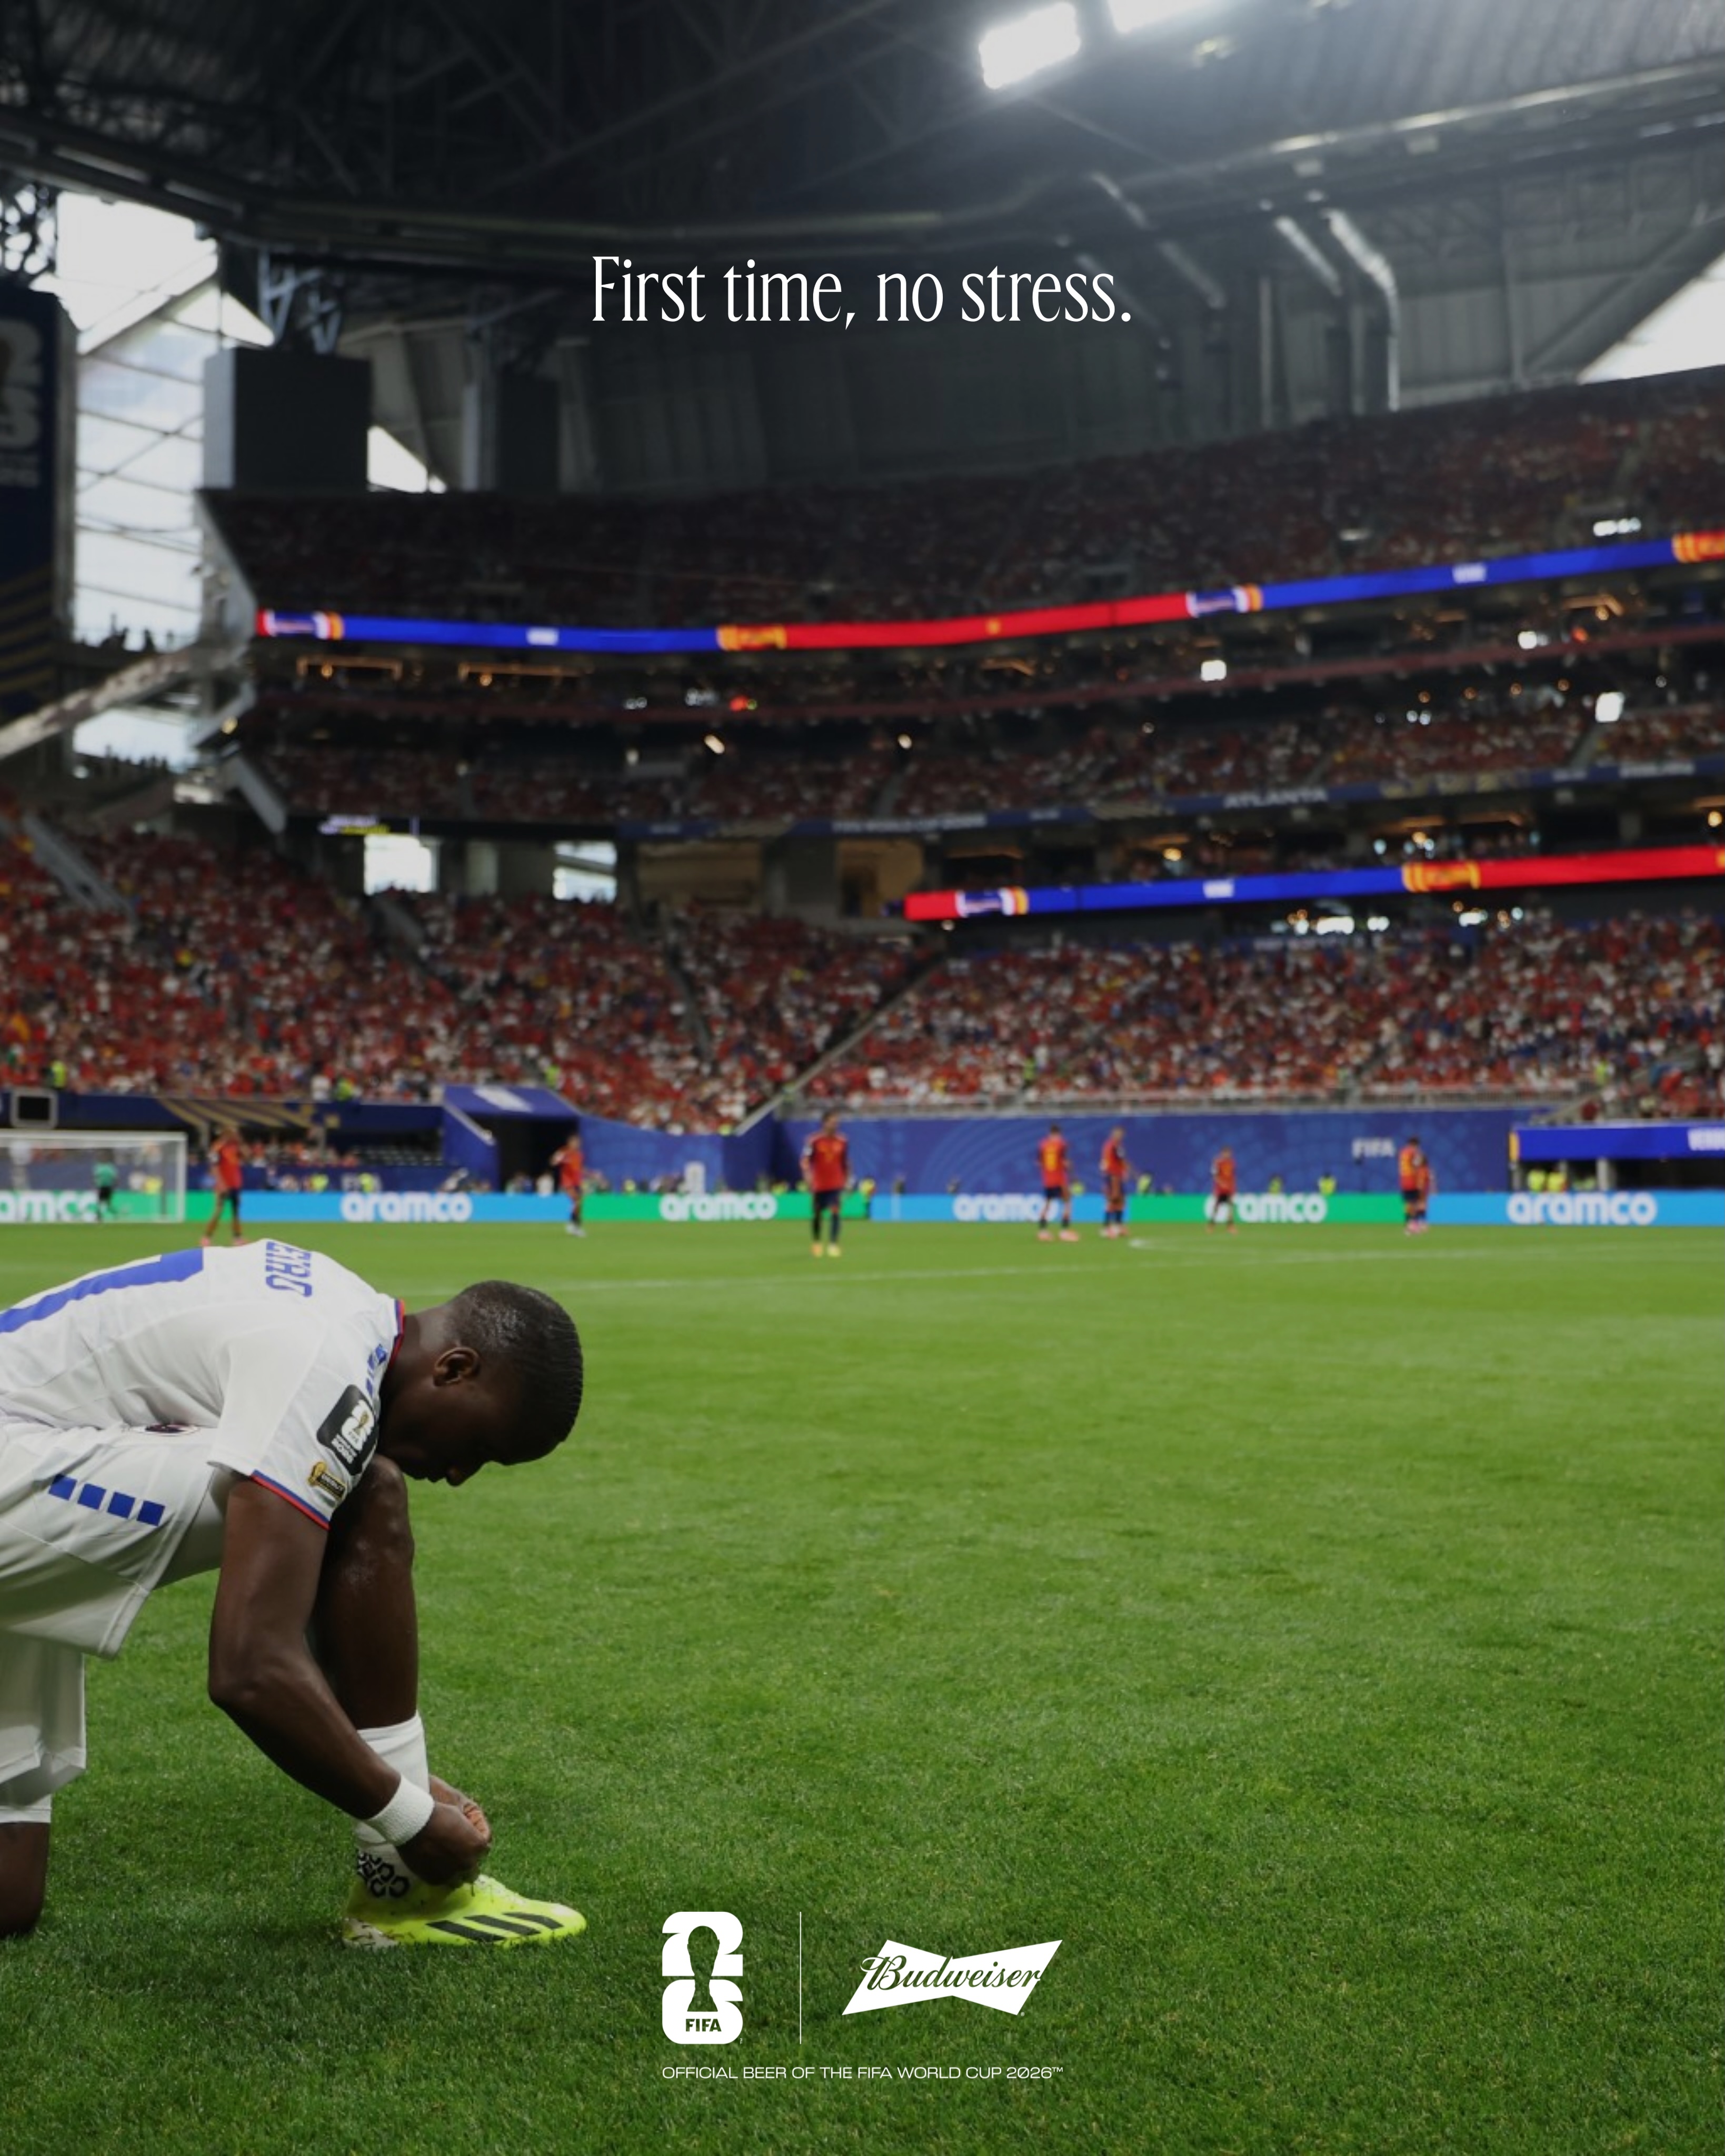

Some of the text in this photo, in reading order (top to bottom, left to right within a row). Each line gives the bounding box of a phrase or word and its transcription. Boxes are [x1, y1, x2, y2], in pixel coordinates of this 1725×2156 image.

[341, 1191, 472, 1222] aramco
[660, 1192, 776, 1221] aramco
[1508, 1192, 1657, 1225] aramco
